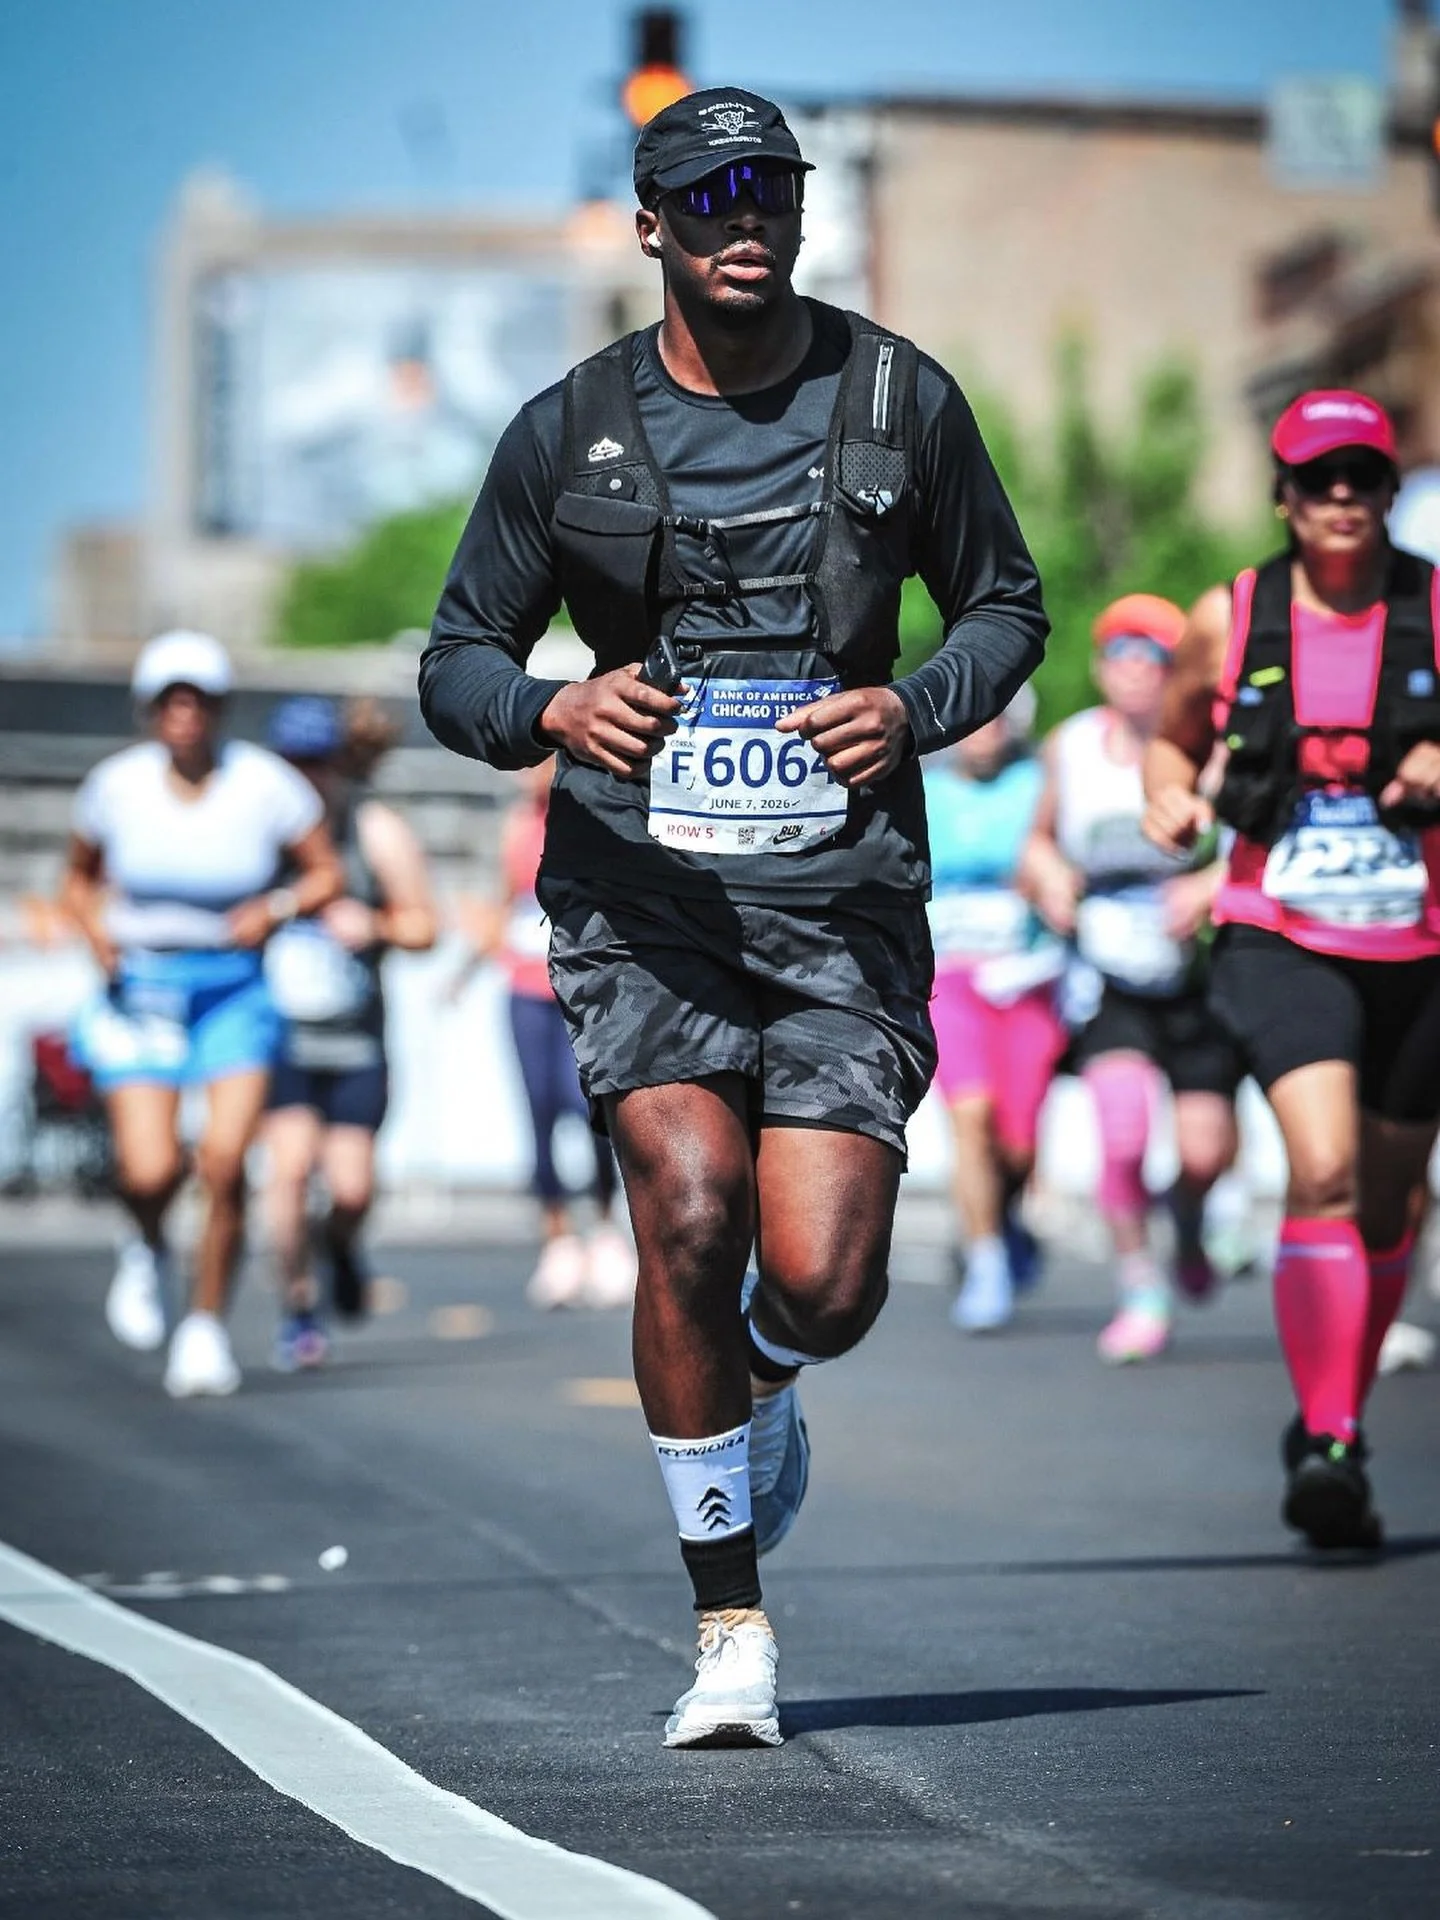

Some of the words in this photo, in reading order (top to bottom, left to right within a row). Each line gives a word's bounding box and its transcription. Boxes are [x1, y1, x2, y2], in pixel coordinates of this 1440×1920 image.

[712, 690, 743, 701] BANK
[746, 691, 760, 701] OF
[763, 692, 813, 701] AMERICA
[711, 704, 771, 718] CHICAGO
[774, 705, 796, 718] 131
[671, 751, 694, 784] F
[703, 737, 834, 788] 6064
[709, 799, 741, 810] JUNE
[745, 799, 756, 811] 7,
[760, 799, 790, 809] 2026
[667, 824, 701, 838] ROW
[705, 827, 714, 839] 5
[779, 825, 804, 836] RUN
[819, 827, 827, 836] 6
[658, 1435, 745, 1457] RYMORA
